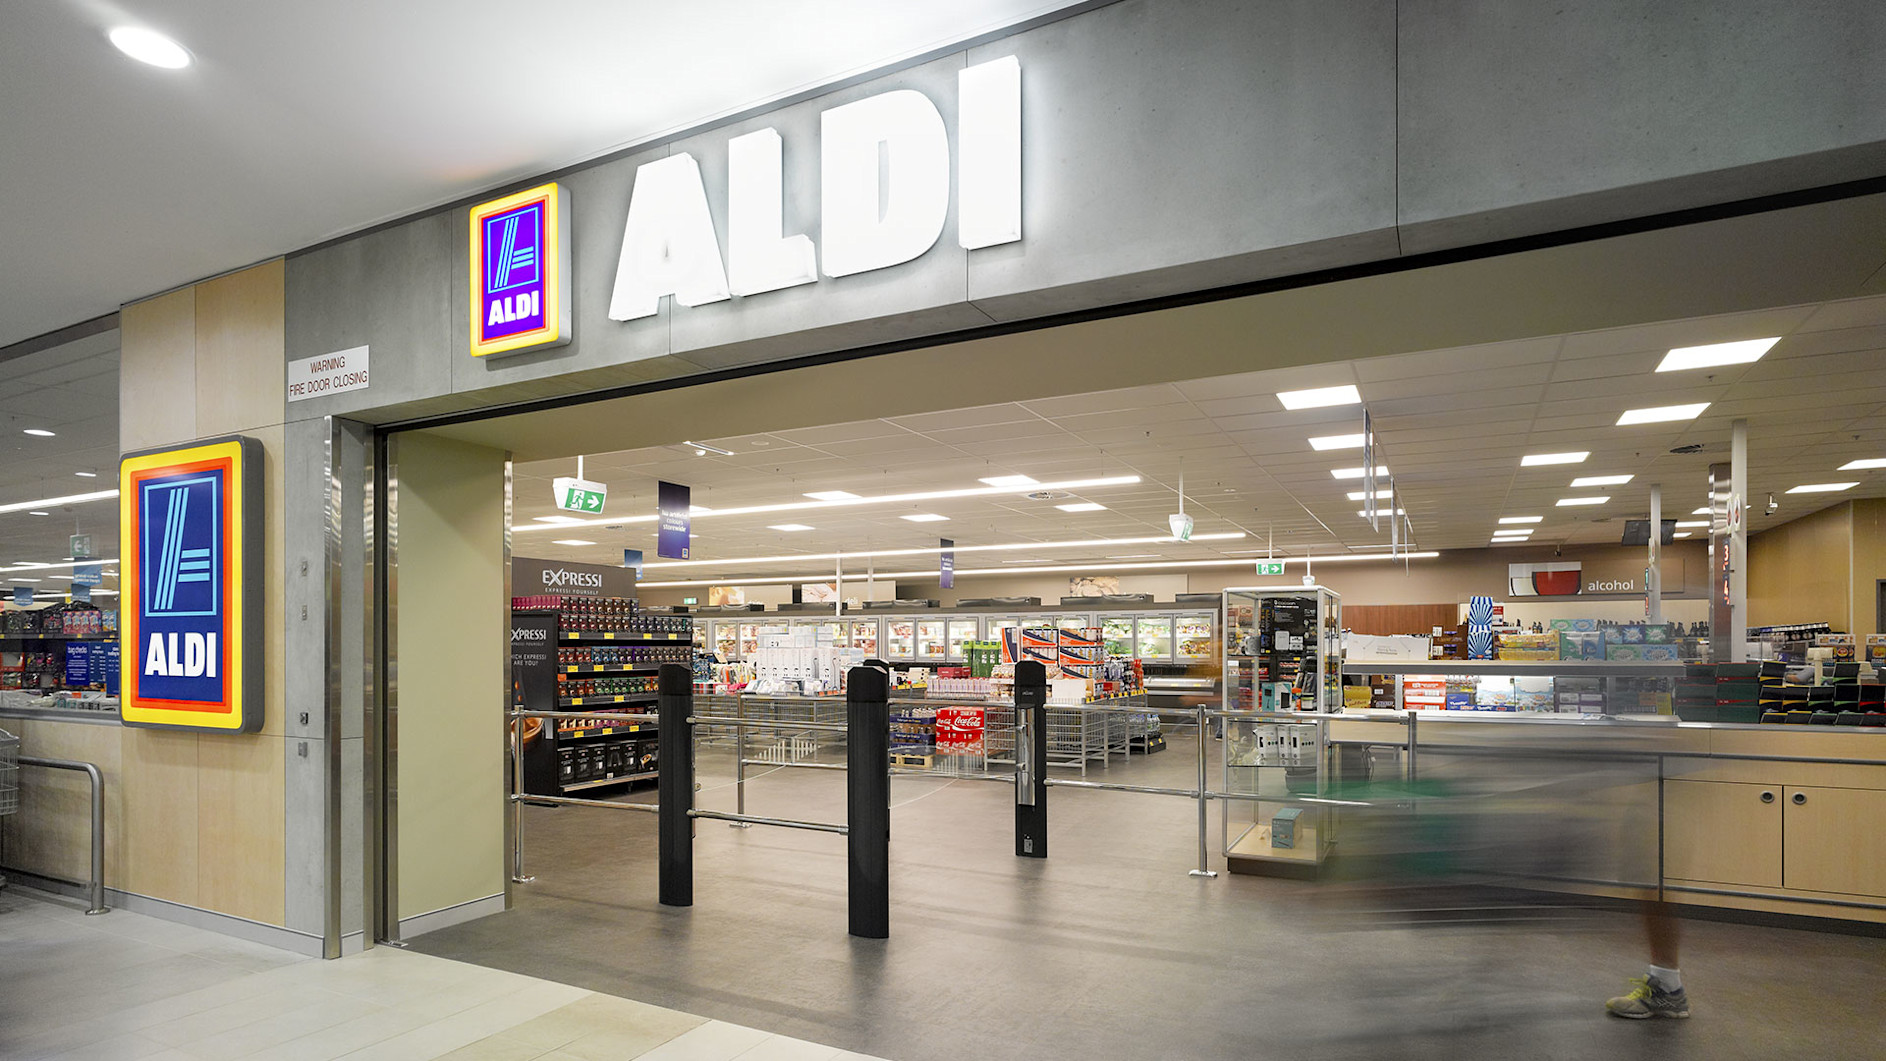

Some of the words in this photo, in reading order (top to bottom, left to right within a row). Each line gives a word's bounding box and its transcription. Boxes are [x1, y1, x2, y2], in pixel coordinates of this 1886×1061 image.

[608, 54, 1022, 322] ALDI
[488, 290, 540, 326] ALDI
[310, 356, 346, 374] WARNING
[289, 382, 305, 396] FIRE
[307, 378, 331, 393] DOOR
[333, 370, 368, 388] CLOSING
[542, 568, 602, 587] EXPRESSI
[1588, 579, 1634, 591] alcohol
[511, 628, 546, 641] XPRESSI
[144, 632, 217, 678] ALDI
[523, 653, 547, 661] EXPRESSI
